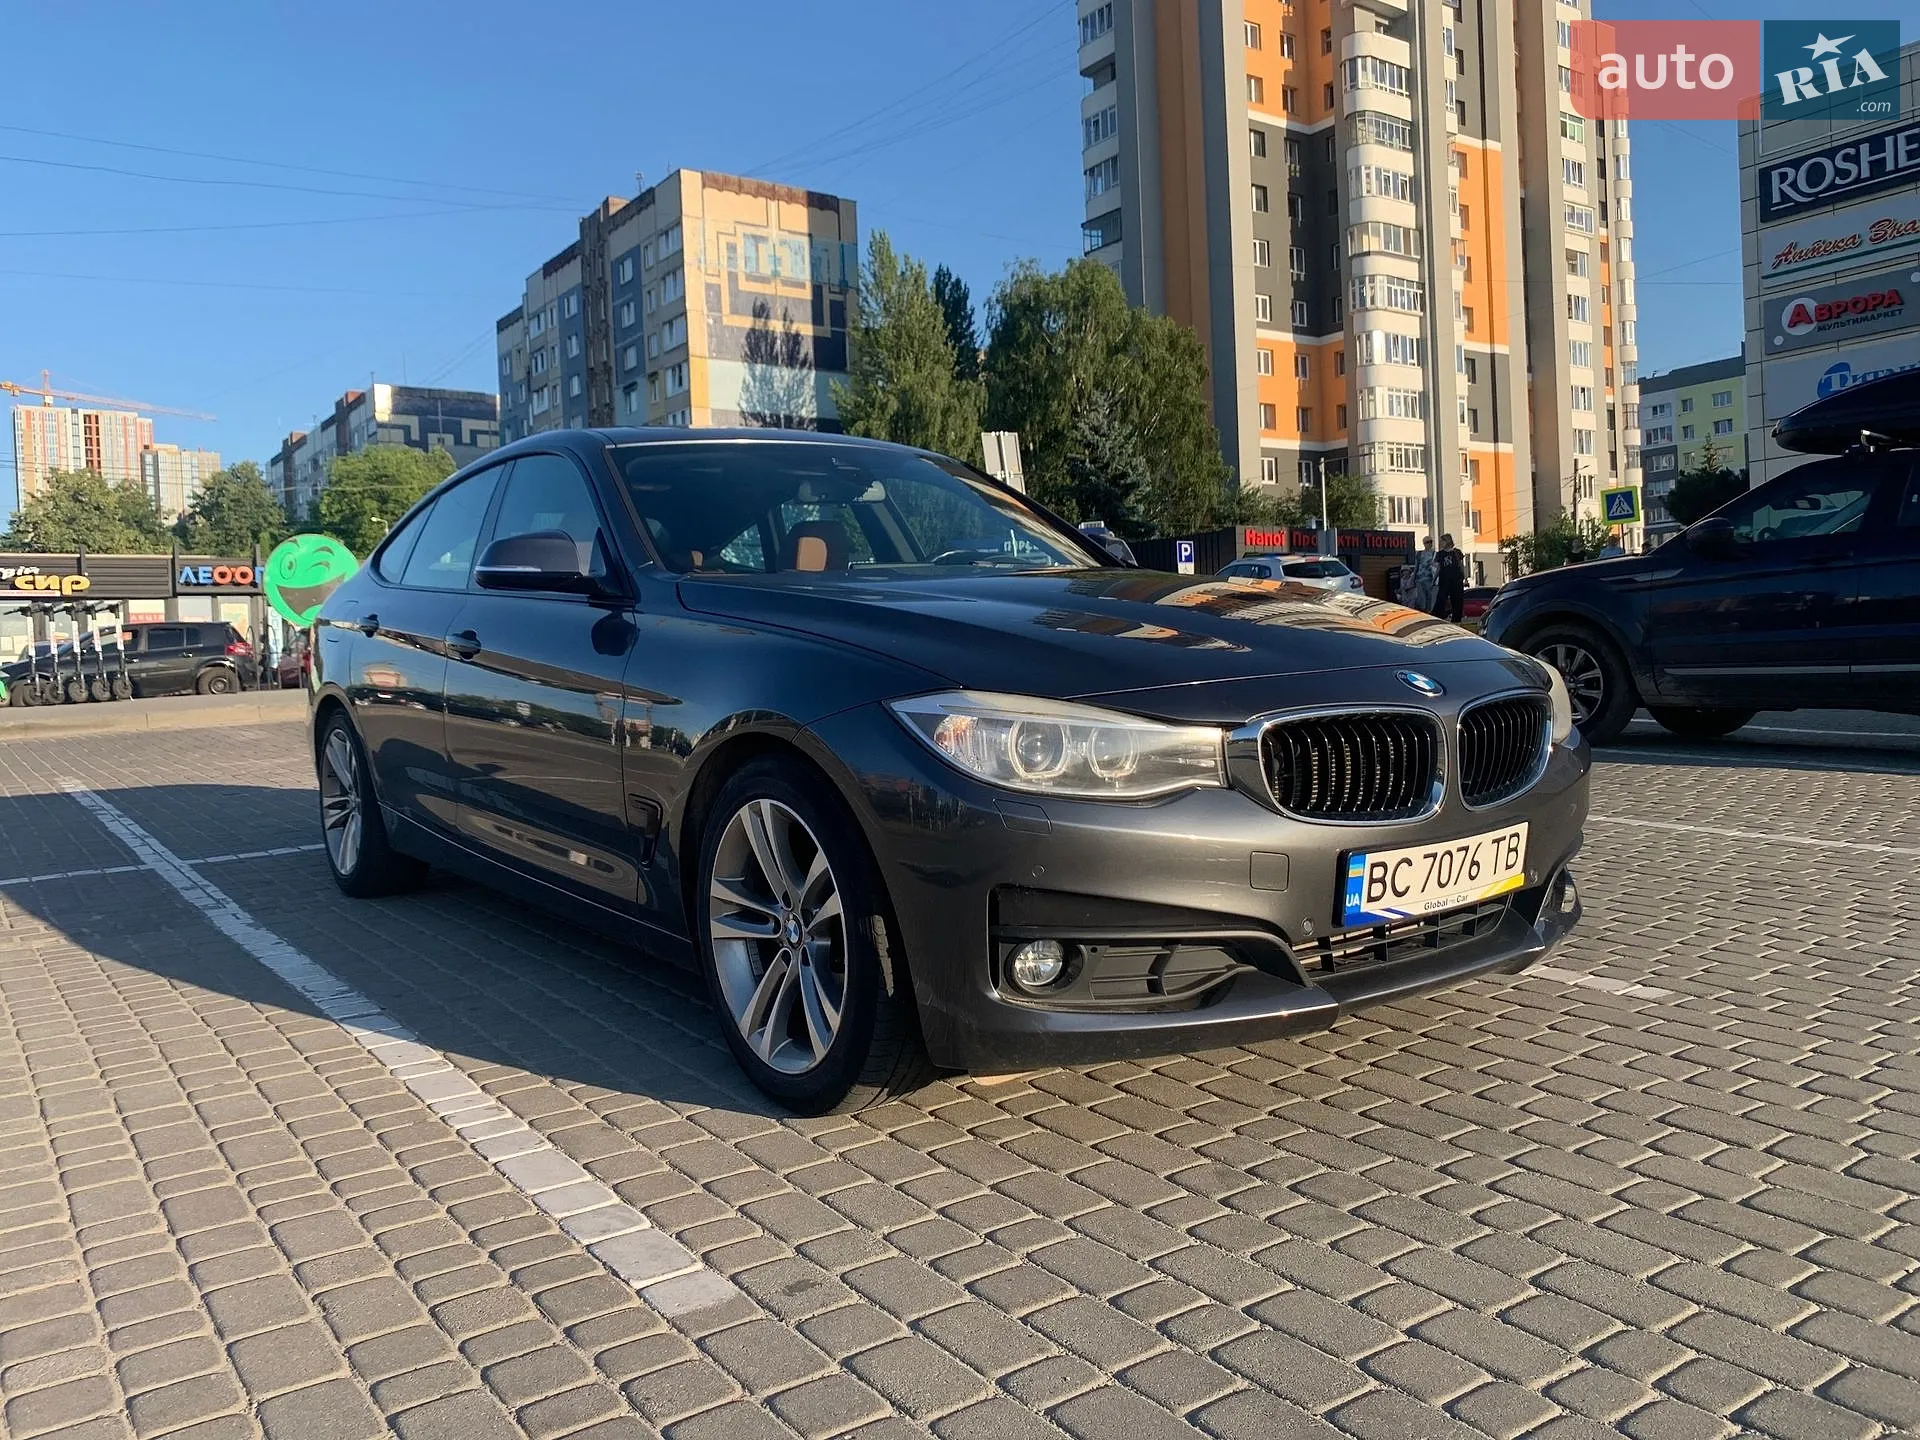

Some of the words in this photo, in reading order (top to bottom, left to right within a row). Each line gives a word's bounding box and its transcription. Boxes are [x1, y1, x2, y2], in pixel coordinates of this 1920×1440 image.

[1771, 232, 1862, 270] Аптека
[1816, 308, 1905, 333] МУЛЬТИМАРКЕТ
[1245, 528, 1286, 547] Напої
[1292, 530, 1360, 547] Прокти
[1181, 543, 1191, 562] P
[1366, 856, 1413, 903] BC
[1420, 841, 1483, 893] 7076
[1491, 831, 1521, 876] TB
[1345, 892, 1360, 908] UA
[1423, 897, 1449, 911] Global
